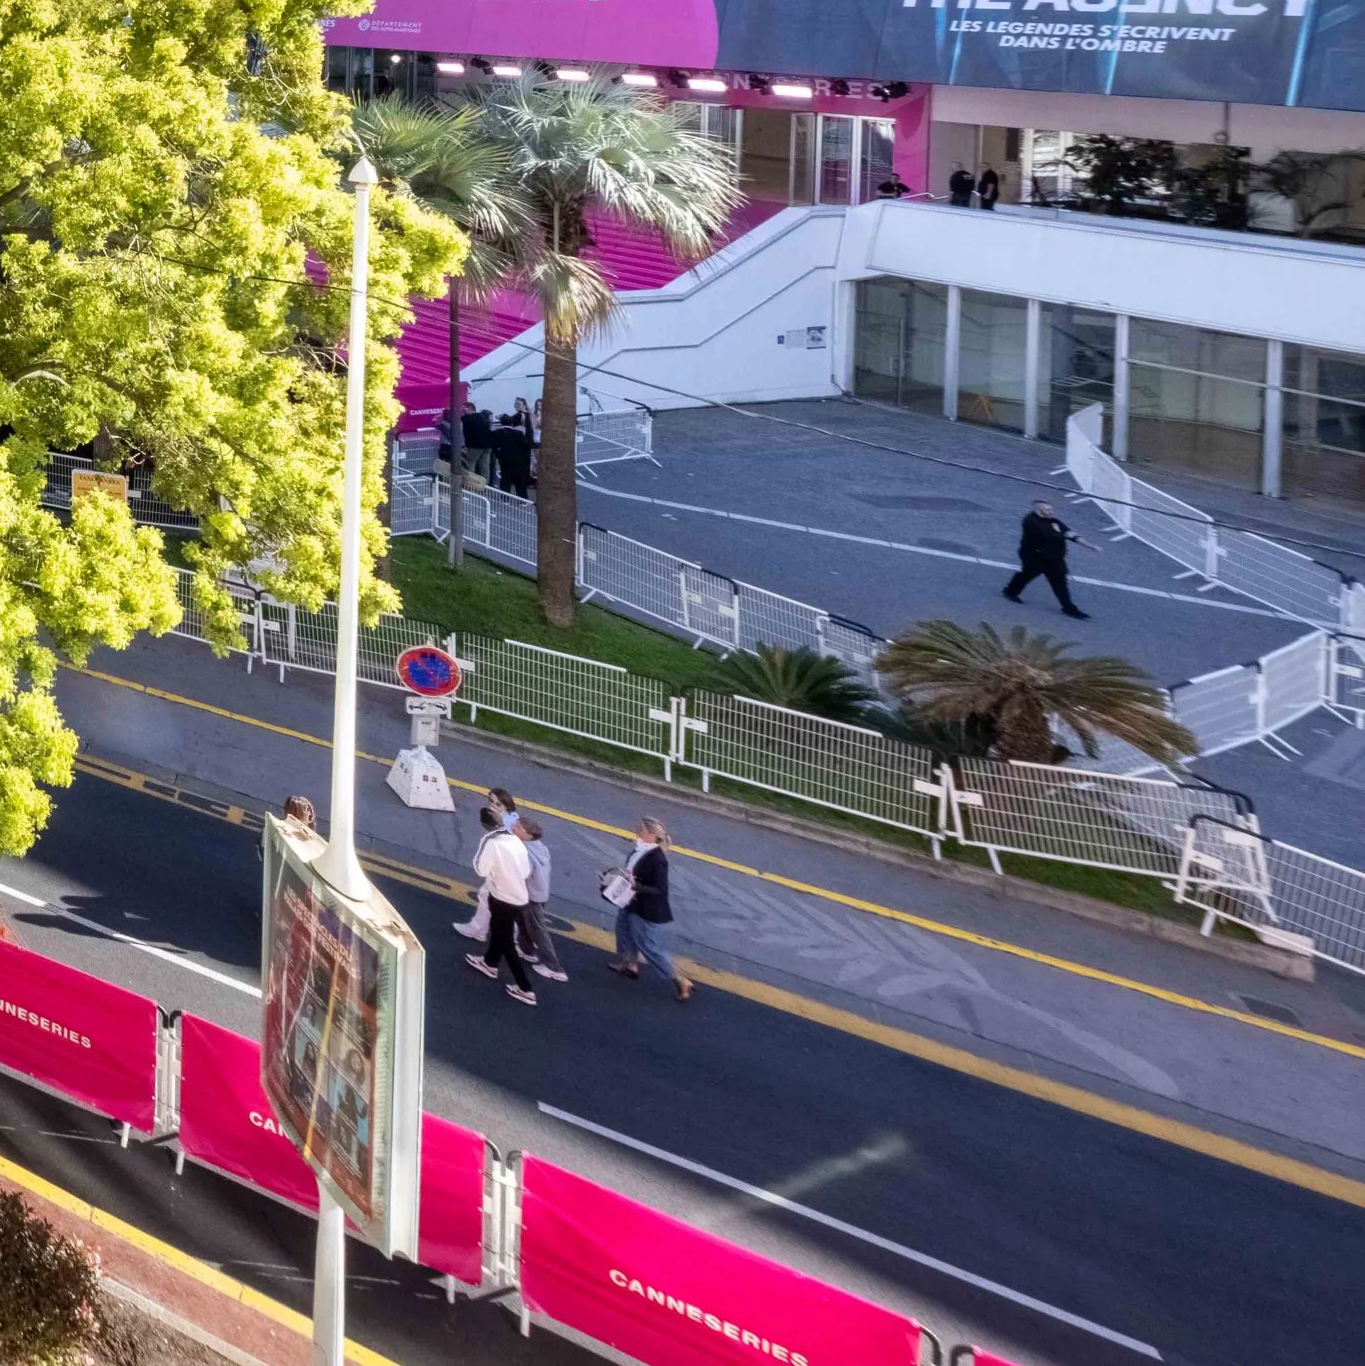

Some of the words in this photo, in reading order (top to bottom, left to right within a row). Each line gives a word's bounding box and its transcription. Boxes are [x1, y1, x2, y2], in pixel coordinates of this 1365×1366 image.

[949, 19, 983, 33] LES
[998, 34, 1060, 50] DANS
[1065, 36, 1168, 54] L'OMBRE
[609, 1269, 809, 1366] CANNESERIES
